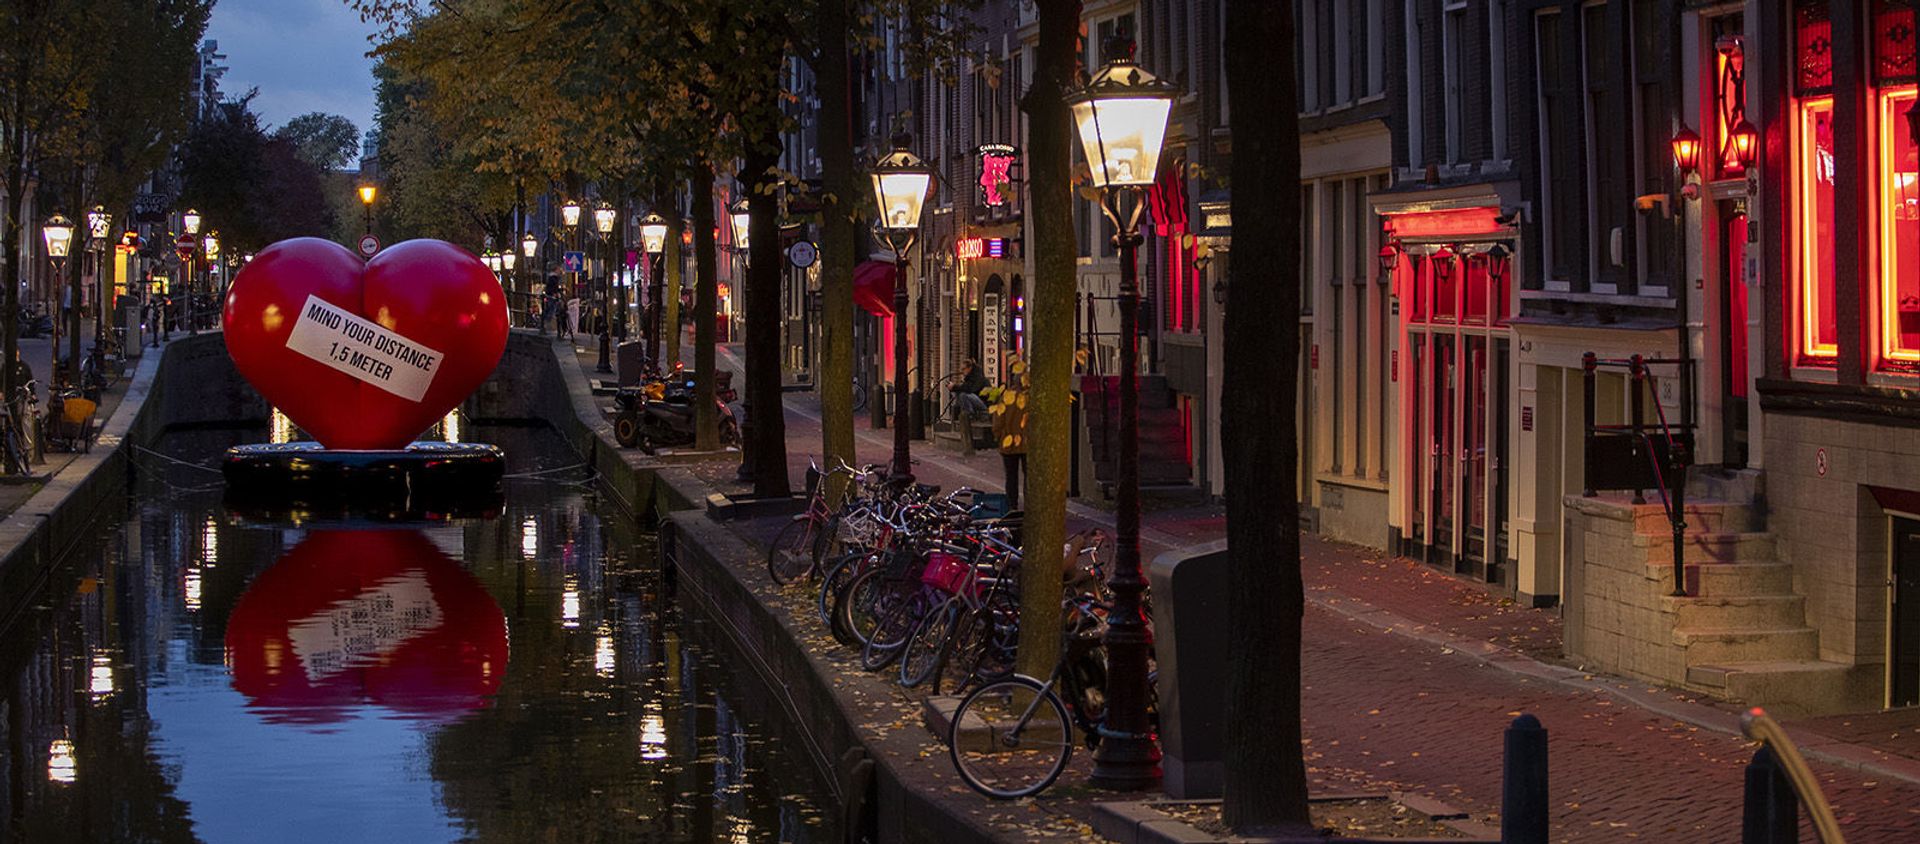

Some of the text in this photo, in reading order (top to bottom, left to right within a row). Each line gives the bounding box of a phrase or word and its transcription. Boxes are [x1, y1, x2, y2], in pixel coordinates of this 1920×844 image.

[307, 304, 435, 371] MIND YOUR DISTANCE
[329, 342, 393, 380] 1,5 METER
